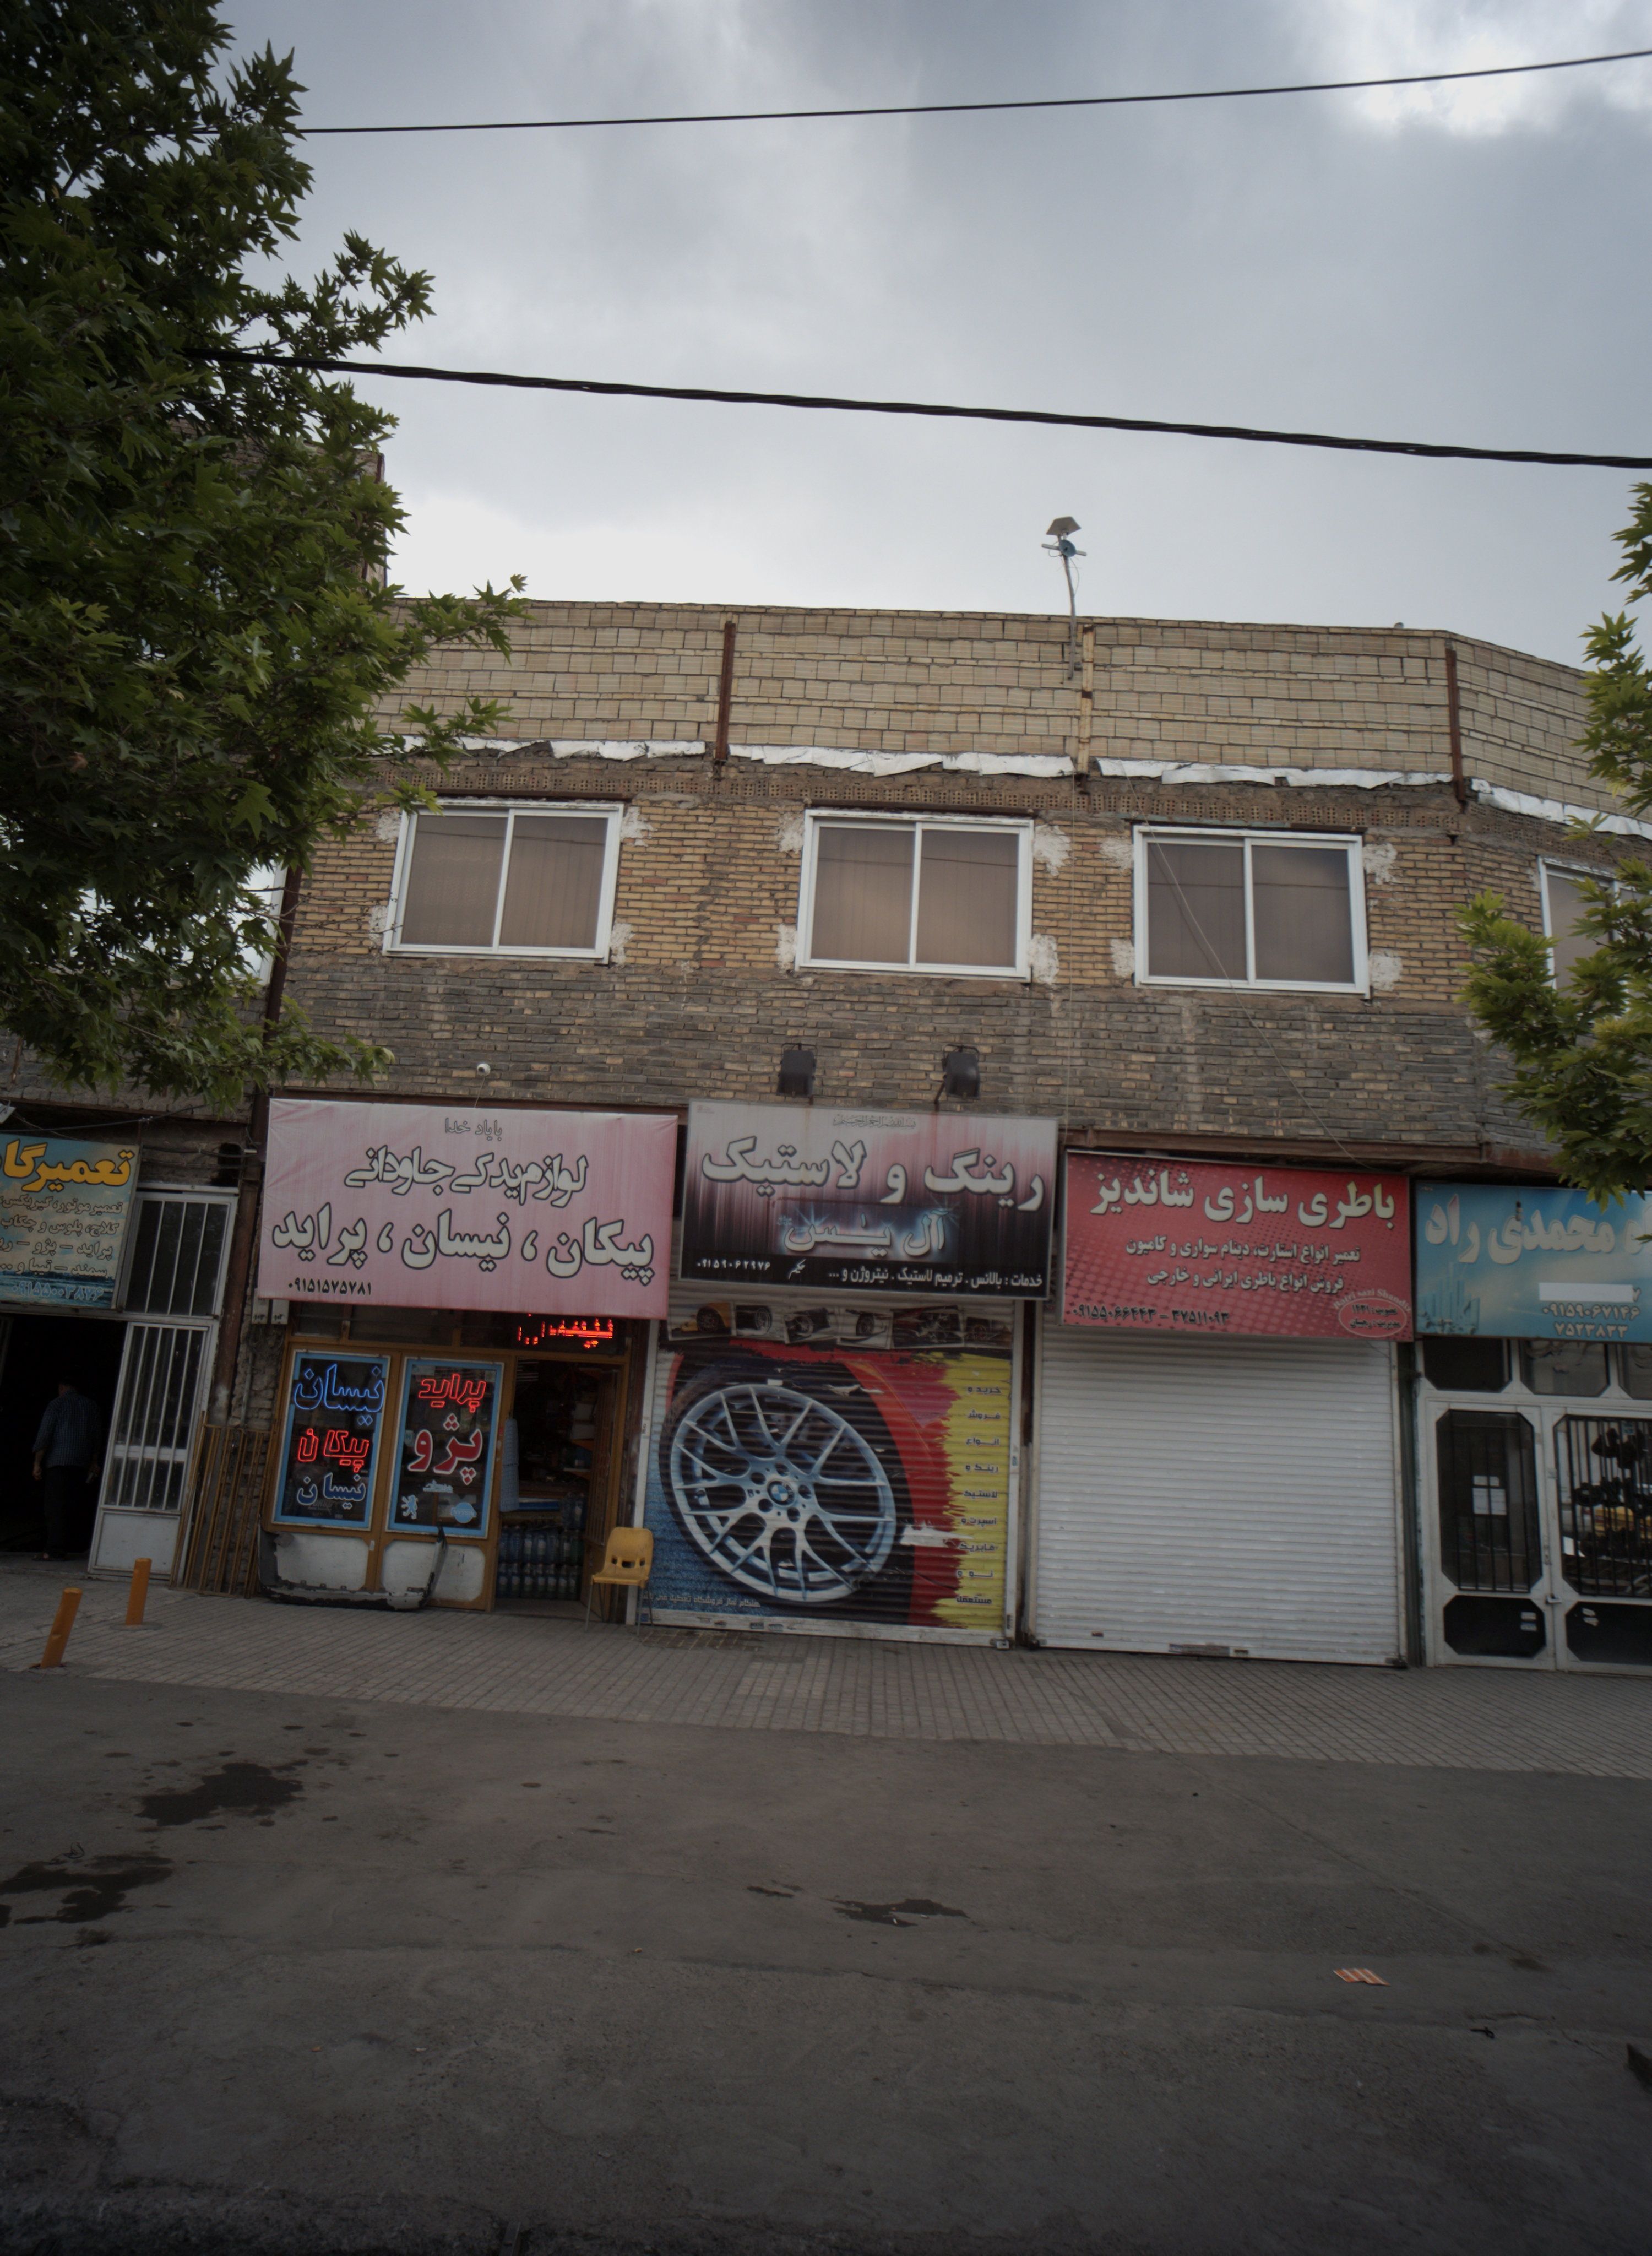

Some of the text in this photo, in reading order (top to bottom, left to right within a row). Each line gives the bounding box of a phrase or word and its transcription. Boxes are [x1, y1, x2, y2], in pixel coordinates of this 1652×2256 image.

[445, 1117, 471, 1134] خدا
[0, 1138, 135, 1193] تعمیرگا
[702, 1136, 1045, 1212] رینگ و لاستیک
[518, 1153, 589, 1208] لوازم
[1090, 1168, 1396, 1229] باطری سازی شاندیز
[89, 1202, 123, 1216] تعمیر
[38, 1222, 47, 1233] و
[272, 1202, 368, 1269] پراید
[904, 1210, 949, 1256] آل
[1488, 1209, 1616, 1265] محمدی
[32, 1238, 57, 1256] پژو
[401, 1208, 511, 1272] نیسان
[1126, 1234, 1167, 1256] کامیون
[1179, 1237, 1218, 1259] سواری
[1221, 1239, 1250, 1260] دینام
[77, 1241, 113, 1261] پراید
[546, 1216, 655, 1287] پیکان
[1169, 1242, 1177, 1258] و
[1300, 1243, 1329, 1265] انواع
[1332, 1246, 1361, 1266] تعمیر
[15, 1262, 25, 1275] و
[29, 1257, 52, 1276] تیبا
[71, 1263, 108, 1277] سمند
[841, 1270, 849, 1282] و
[851, 1265, 889, 1283] نیتروژن
[897, 1266, 932, 1285] لاستیک
[289, 1277, 371, 1295] ۰۹۱۵۱۵۷۵۷۸۱
[934, 1271, 963, 1288] ترمیم
[971, 1271, 1002, 1289] بالانس
[1011, 1272, 1042, 1287] خدمات
[1147, 1265, 1344, 1294] فروش انواع باطری ایرانی و خارجی
[1542, 1302, 1640, 1321] ۰۹۱۵۹۰۶۷۱۴۶
[294, 1362, 385, 1427] نیسان
[418, 1373, 487, 1413] پراید
[976, 1386, 1002, 1395] خرید
[967, 1409, 1001, 1420] فروش
[297, 1428, 369, 1473] پیکان
[407, 1413, 483, 1485] پژو
[966, 1437, 1000, 1446] انواع
[296, 1472, 366, 1510] نیسان
[964, 1490, 998, 1499] لاستیک
[970, 1517, 997, 1527] اسپرت
[957, 1593, 992, 1604] مستعمل
